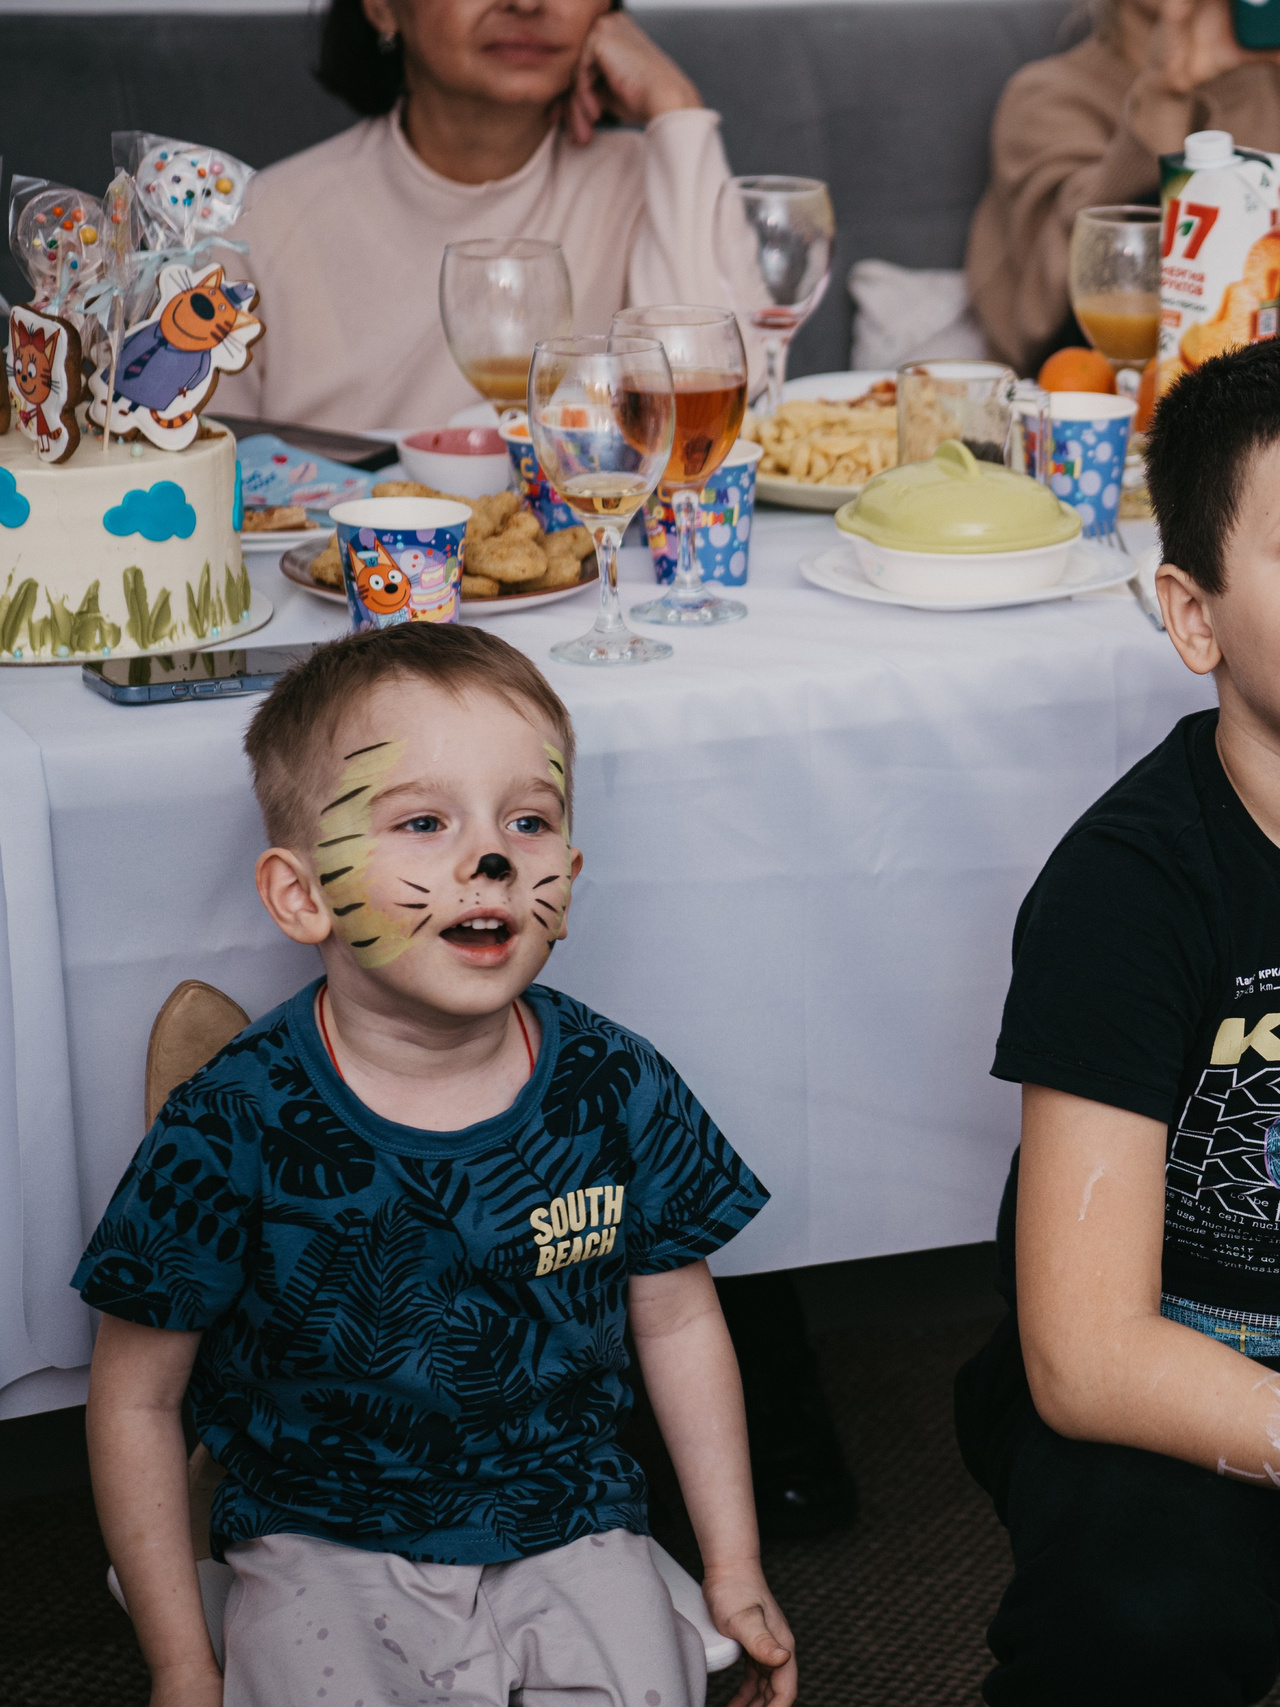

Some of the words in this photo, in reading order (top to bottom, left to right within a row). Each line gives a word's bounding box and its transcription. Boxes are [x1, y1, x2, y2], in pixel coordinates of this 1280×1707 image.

[1252, 1197, 1269, 1207] be
[530, 1185, 624, 1245] SOUTH
[1176, 1209, 1196, 1221] use
[1218, 1212, 1244, 1224] cell
[1165, 1219, 1207, 1235] encode
[535, 1226, 617, 1276] BEACH
[1219, 1243, 1254, 1253] heir
